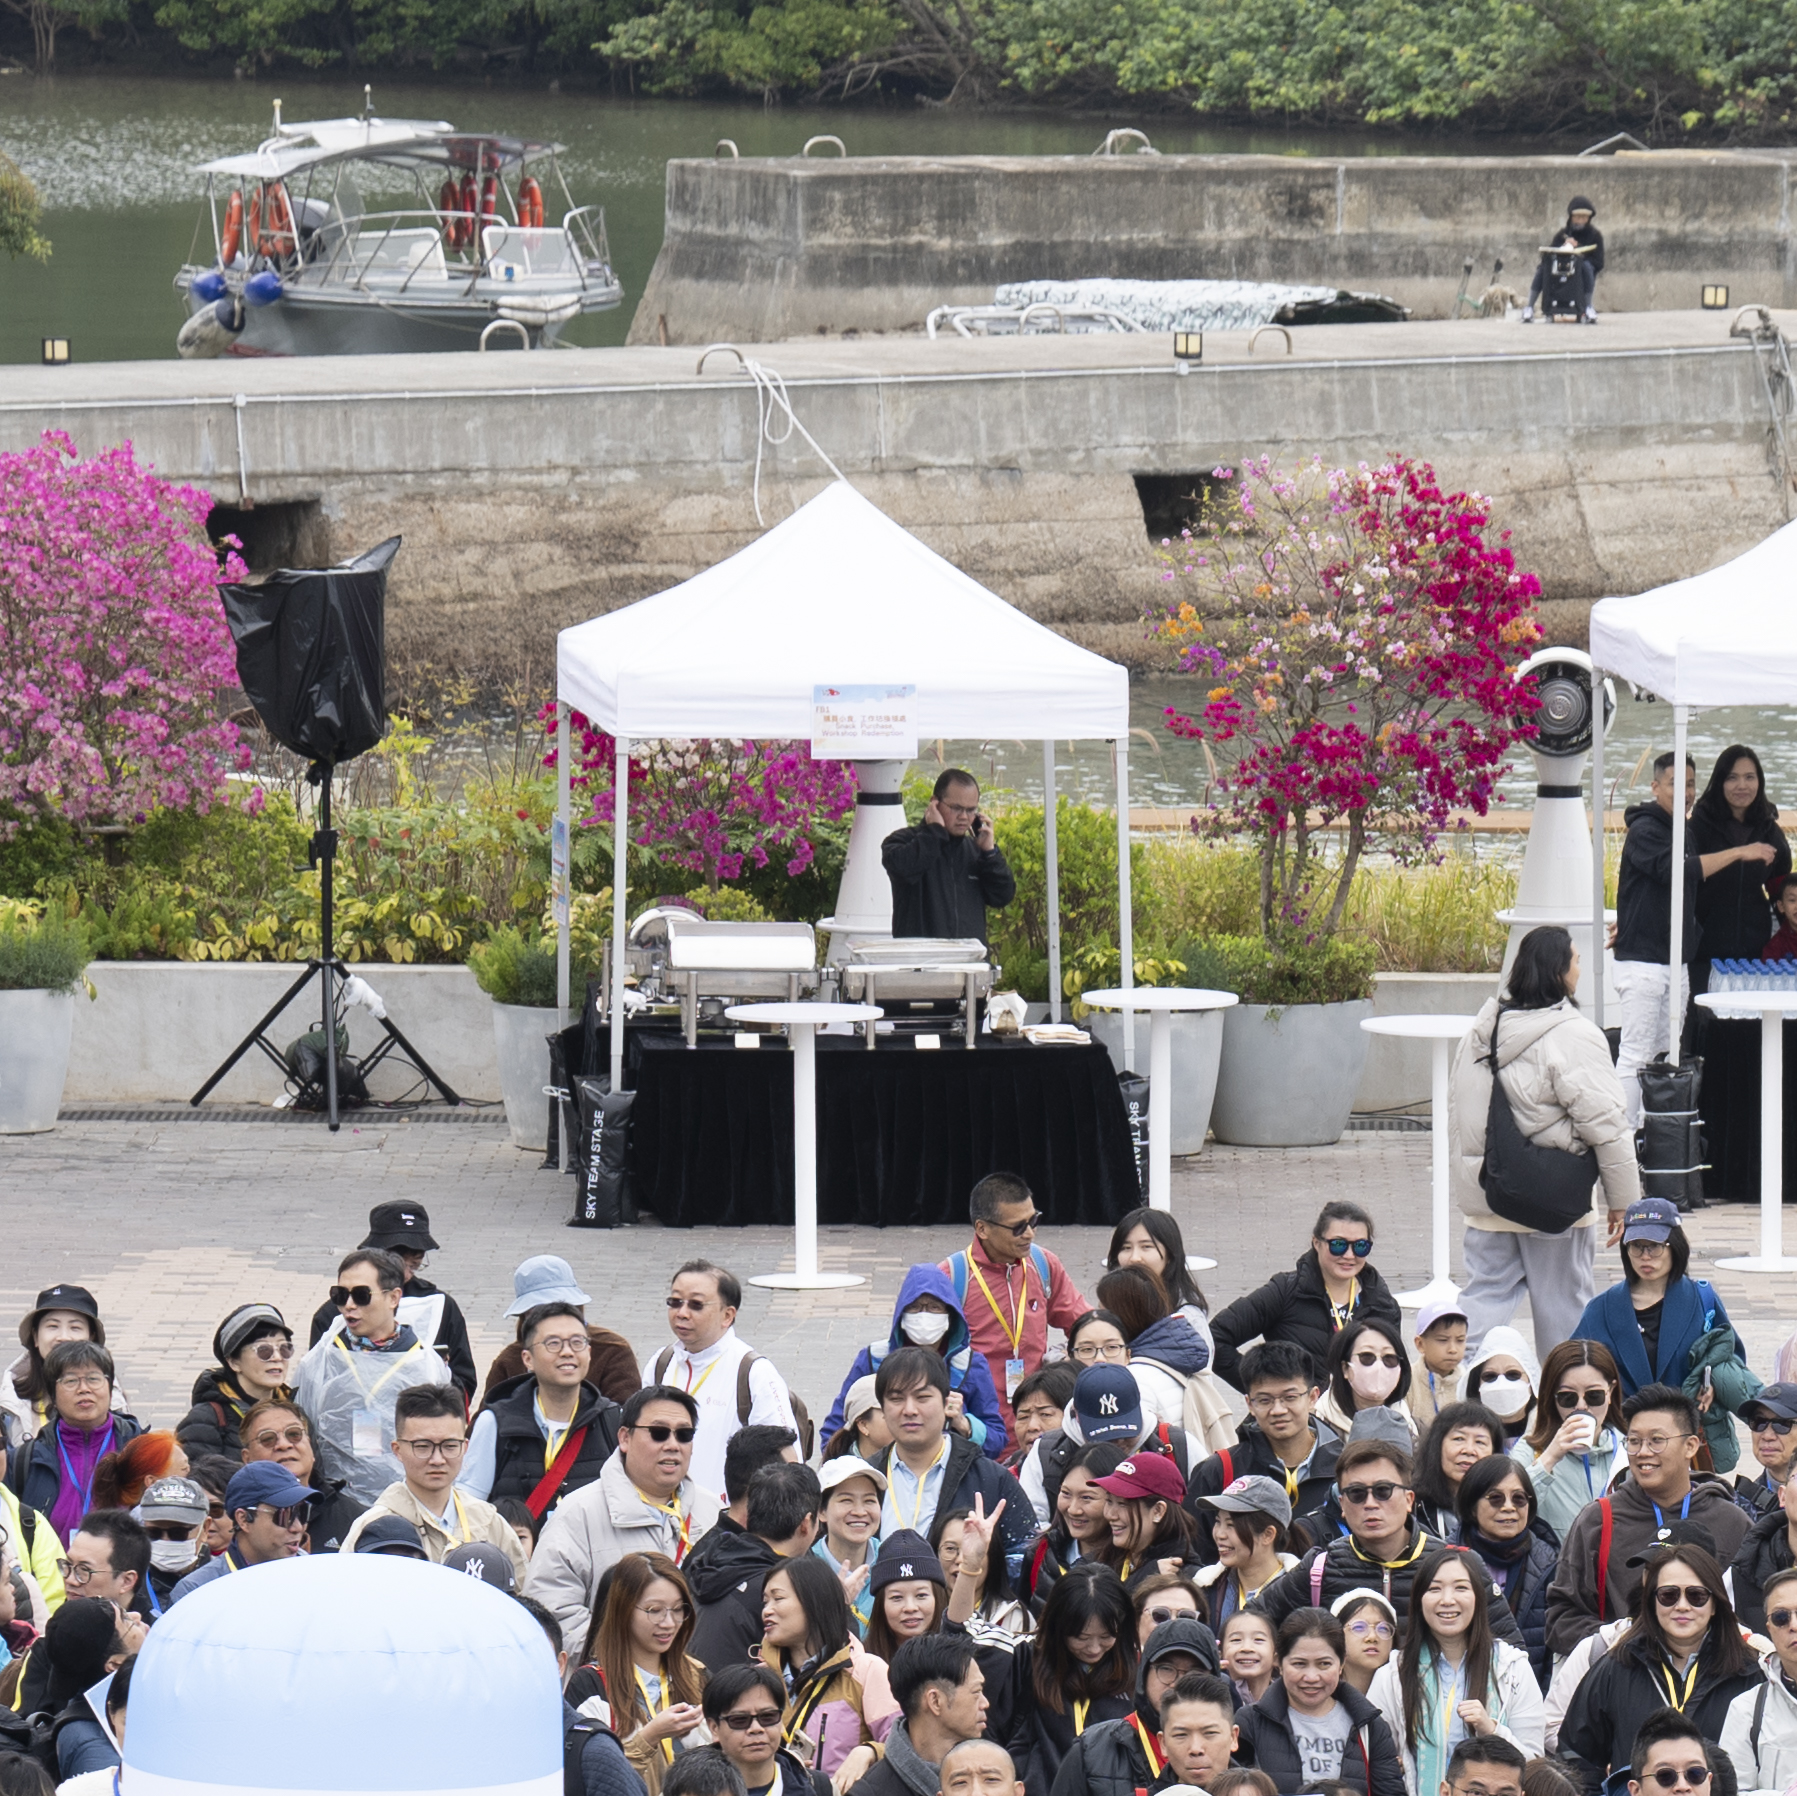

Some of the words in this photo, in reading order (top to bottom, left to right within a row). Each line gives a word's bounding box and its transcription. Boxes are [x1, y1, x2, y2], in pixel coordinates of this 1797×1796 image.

[588, 1156, 601, 1190] TEAM
[585, 1191, 599, 1220] SKY
[1310, 1757, 1332, 1772] OF
